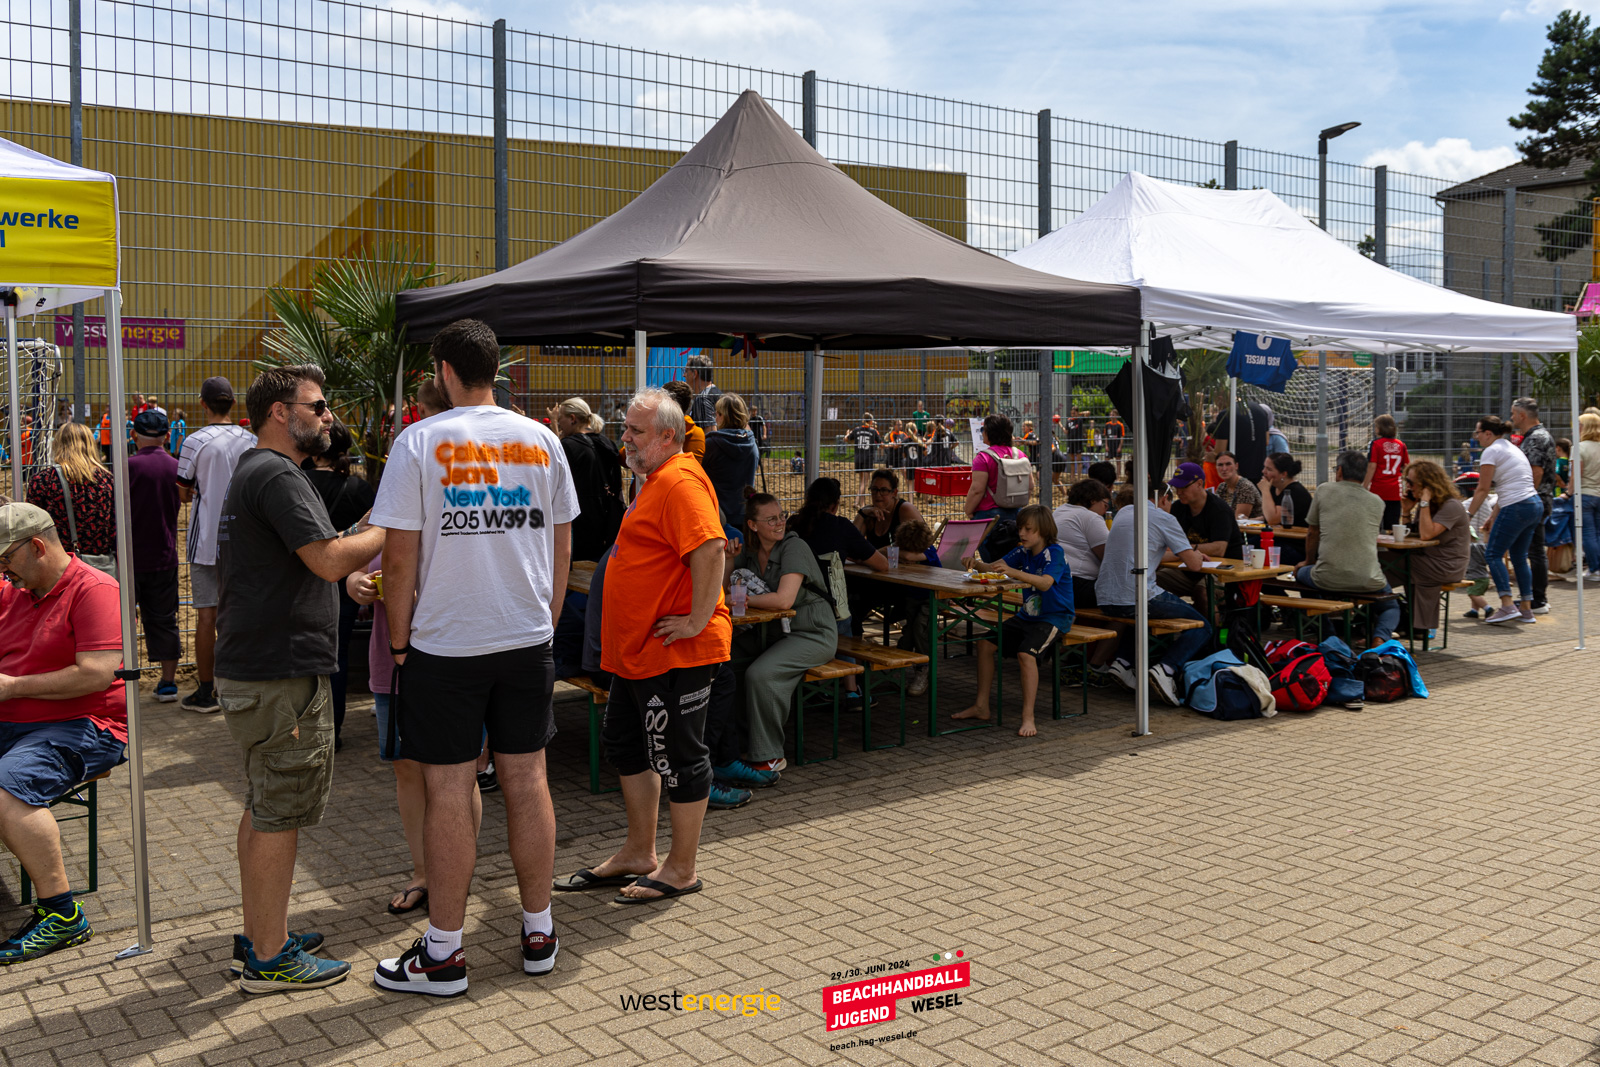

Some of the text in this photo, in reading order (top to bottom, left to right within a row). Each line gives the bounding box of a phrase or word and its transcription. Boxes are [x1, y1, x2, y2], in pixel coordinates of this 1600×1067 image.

[435, 440, 551, 469] Calvin Klein
[1382, 454, 1402, 475] 17
[440, 464, 500, 487] Jeans
[443, 484, 532, 508] New York
[441, 510, 480, 530] 205
[530, 936, 544, 944] NIKE
